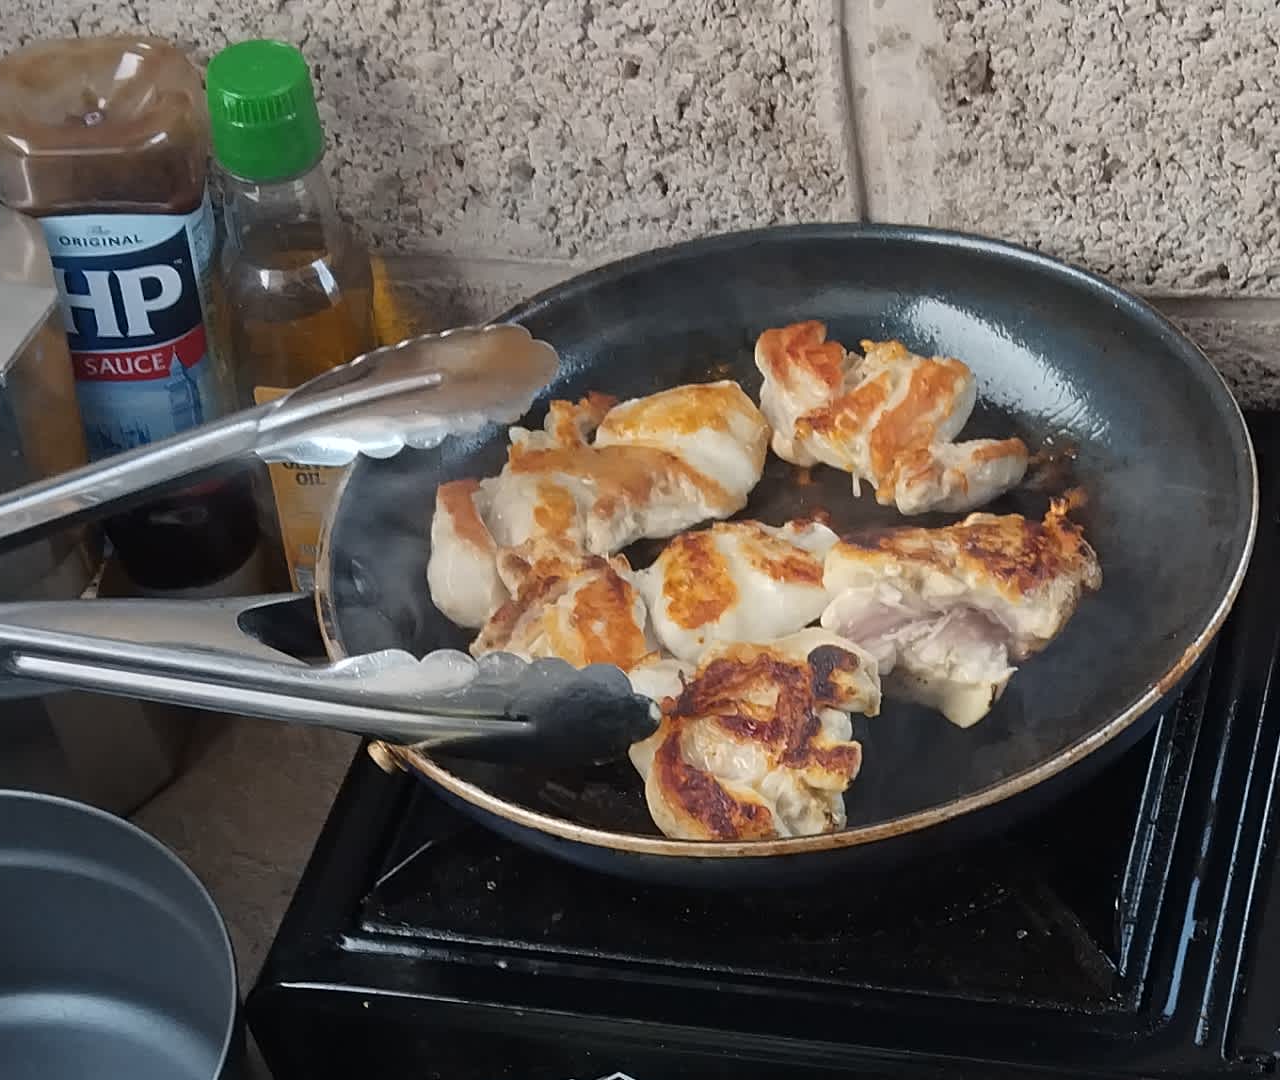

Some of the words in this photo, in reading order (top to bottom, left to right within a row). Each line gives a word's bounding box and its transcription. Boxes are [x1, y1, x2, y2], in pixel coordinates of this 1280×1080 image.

[58, 234, 143, 247] ORIGINAL
[54, 264, 183, 338] HP
[85, 352, 166, 375] SAUCE
[295, 472, 327, 486] OIL
